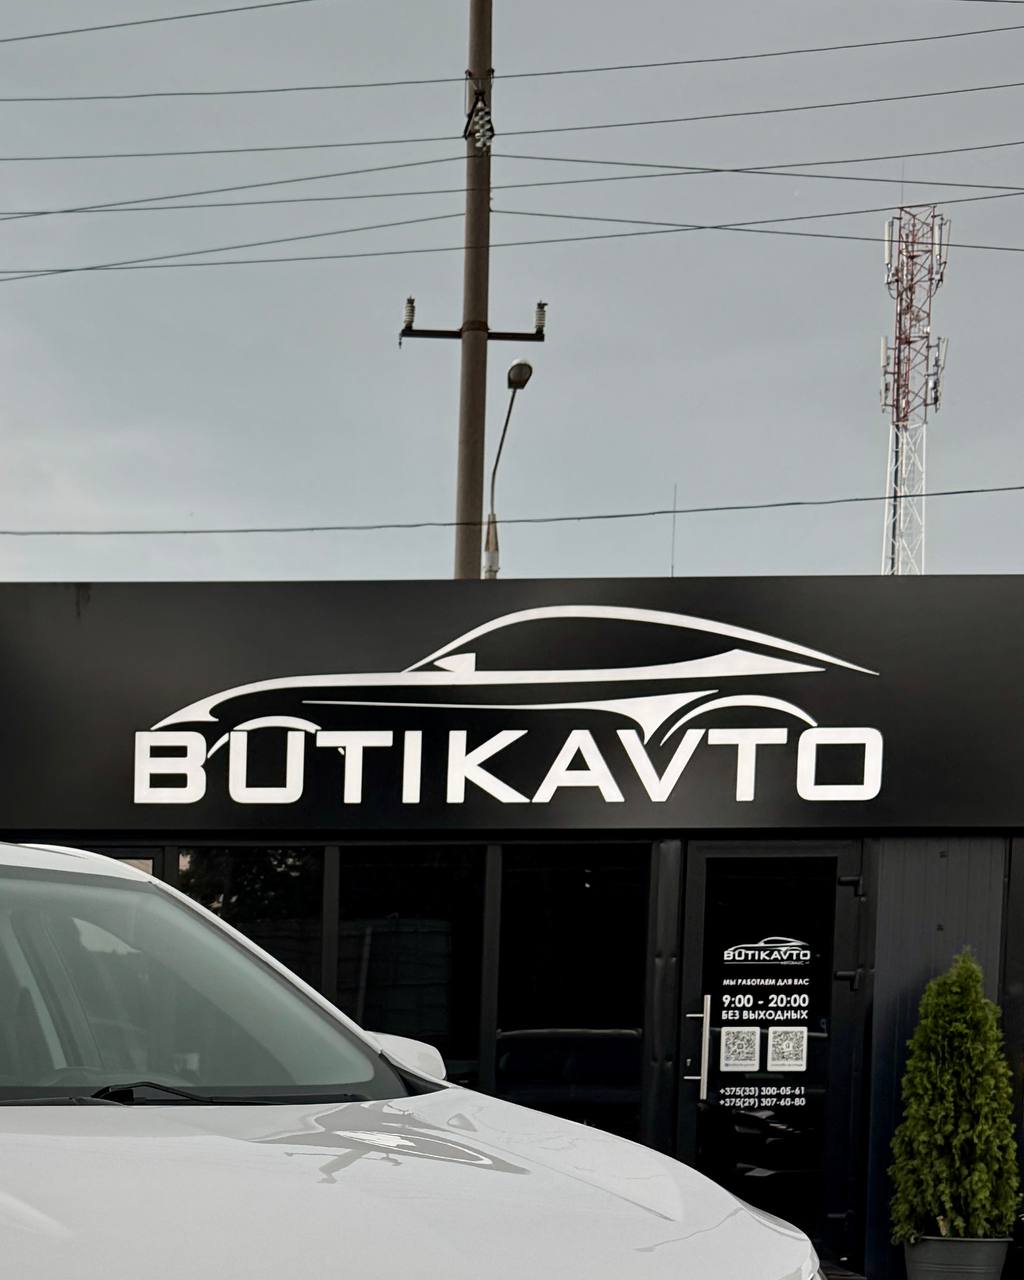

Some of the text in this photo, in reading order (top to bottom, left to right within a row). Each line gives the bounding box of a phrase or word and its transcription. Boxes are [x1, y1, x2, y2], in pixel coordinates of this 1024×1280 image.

[133, 727, 884, 804] BUTIKAVTO
[723, 950, 811, 961] BUTIKAVTO
[737, 978, 776, 986] РАБОТАЕМ
[776, 978, 793, 986] ДЛЯ
[793, 978, 810, 986] ВАС
[722, 994, 754, 1008] 9:00
[768, 994, 809, 1008] 20:00
[721, 1010, 809, 1021] БЕЗ ВЫХОДНЫХ
[719, 1087, 805, 1097] +375(33) 300-05-61
[719, 1098, 806, 1109] +375(29) 307-60-80
